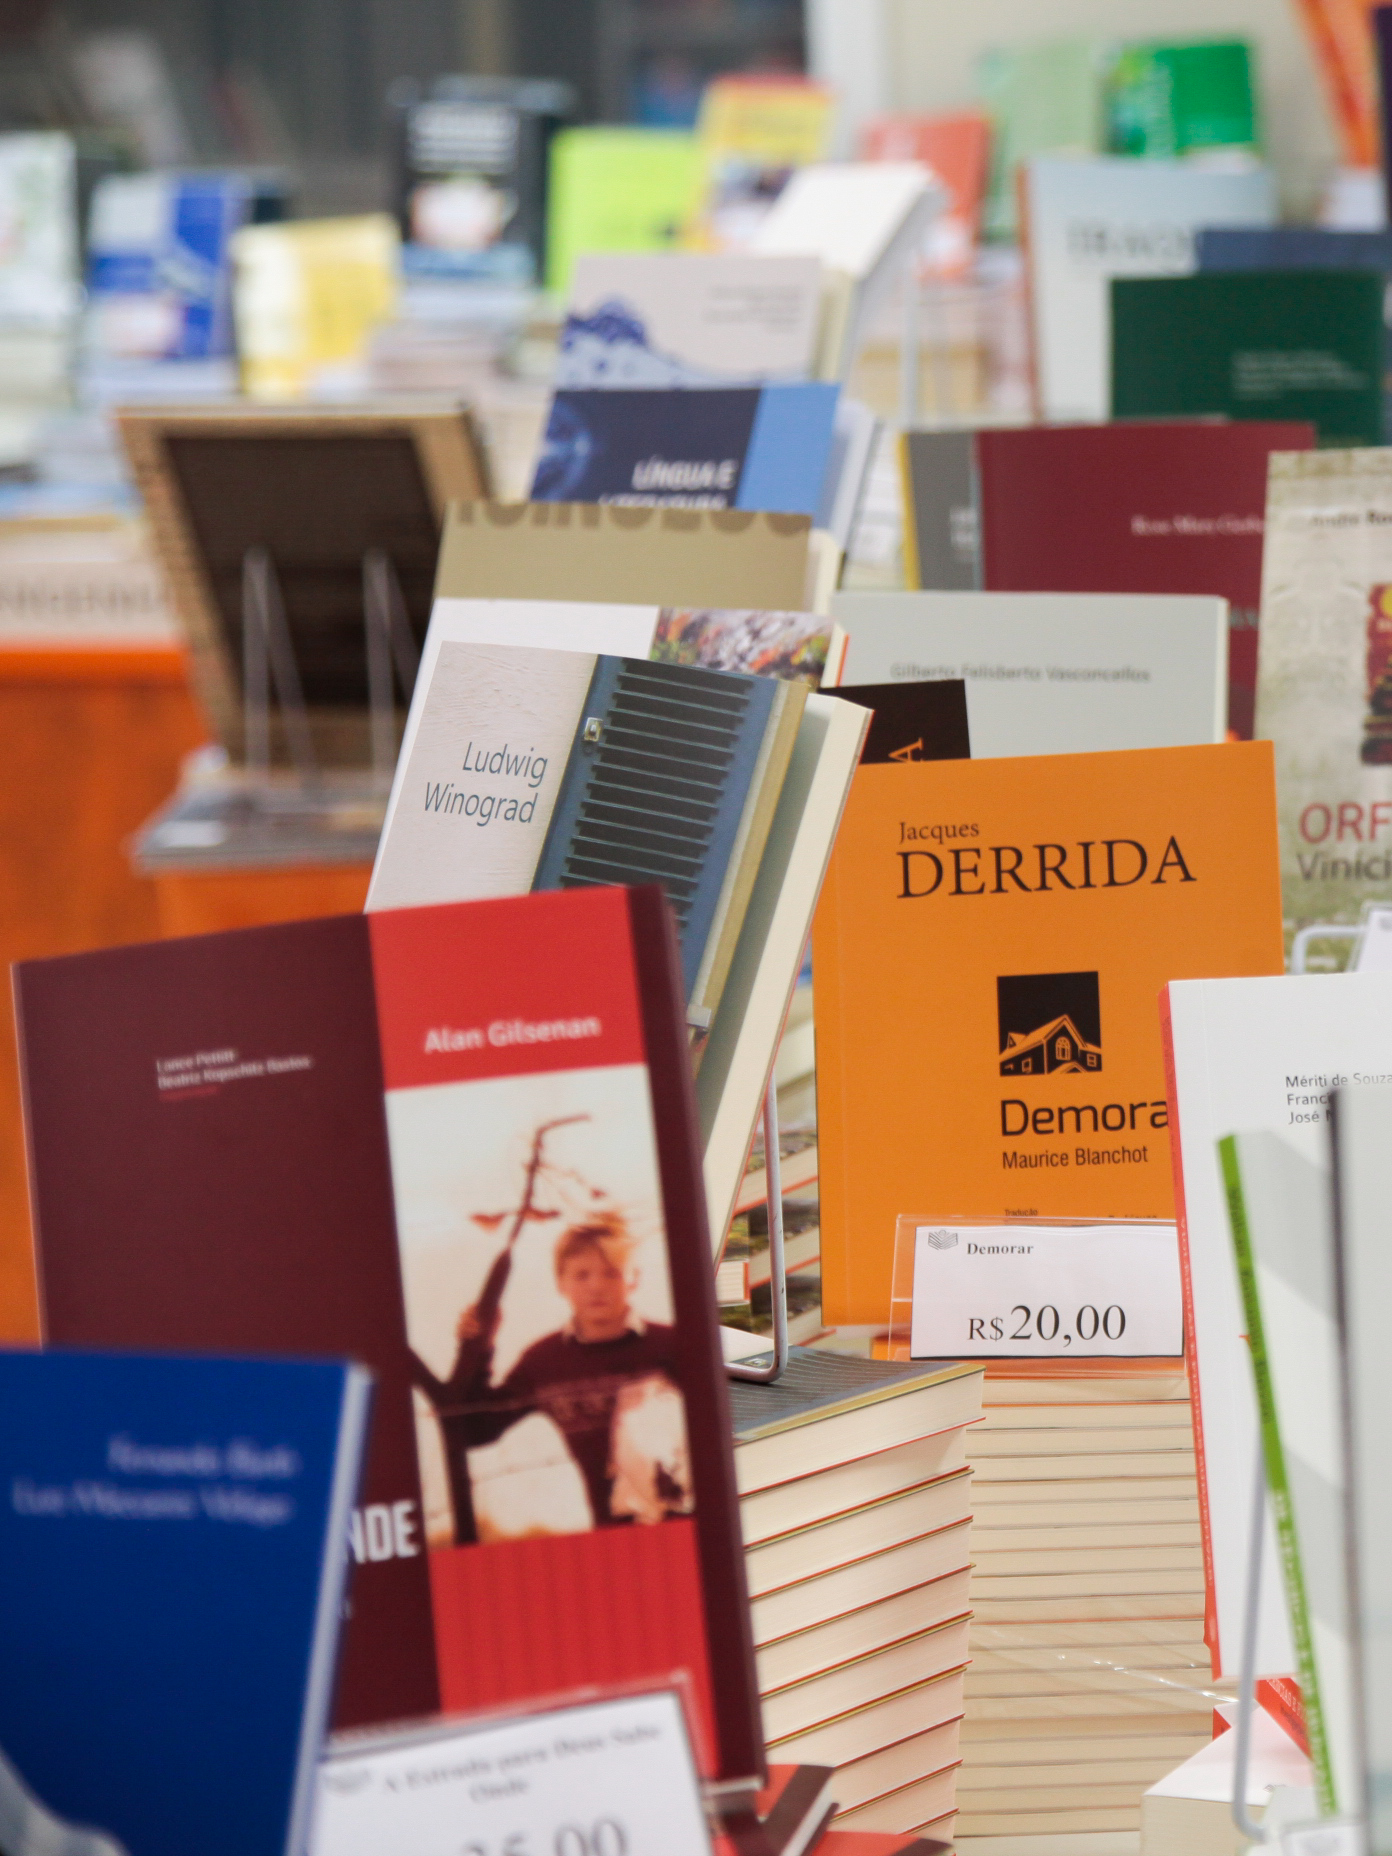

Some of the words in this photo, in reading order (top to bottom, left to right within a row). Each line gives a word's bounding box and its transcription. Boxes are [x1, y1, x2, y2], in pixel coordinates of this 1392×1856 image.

[462, 742, 548, 788] Ludwig
[424, 782, 538, 827] Winograd
[899, 821, 980, 845] Jacques
[896, 835, 1198, 899] DERRIDA
[424, 1028, 484, 1053] Alan
[487, 1016, 602, 1048] Gilsenan
[1285, 1074, 1328, 1088] Mériti
[1332, 1073, 1349, 1087] de
[1001, 1097, 1168, 1136] Demora
[1288, 1111, 1321, 1125] José
[1003, 1149, 1069, 1169] Maurice
[1075, 1145, 1149, 1166] Blanchot
[967, 1242, 1035, 1256] Demorar
[349, 1500, 421, 1565] NDE
